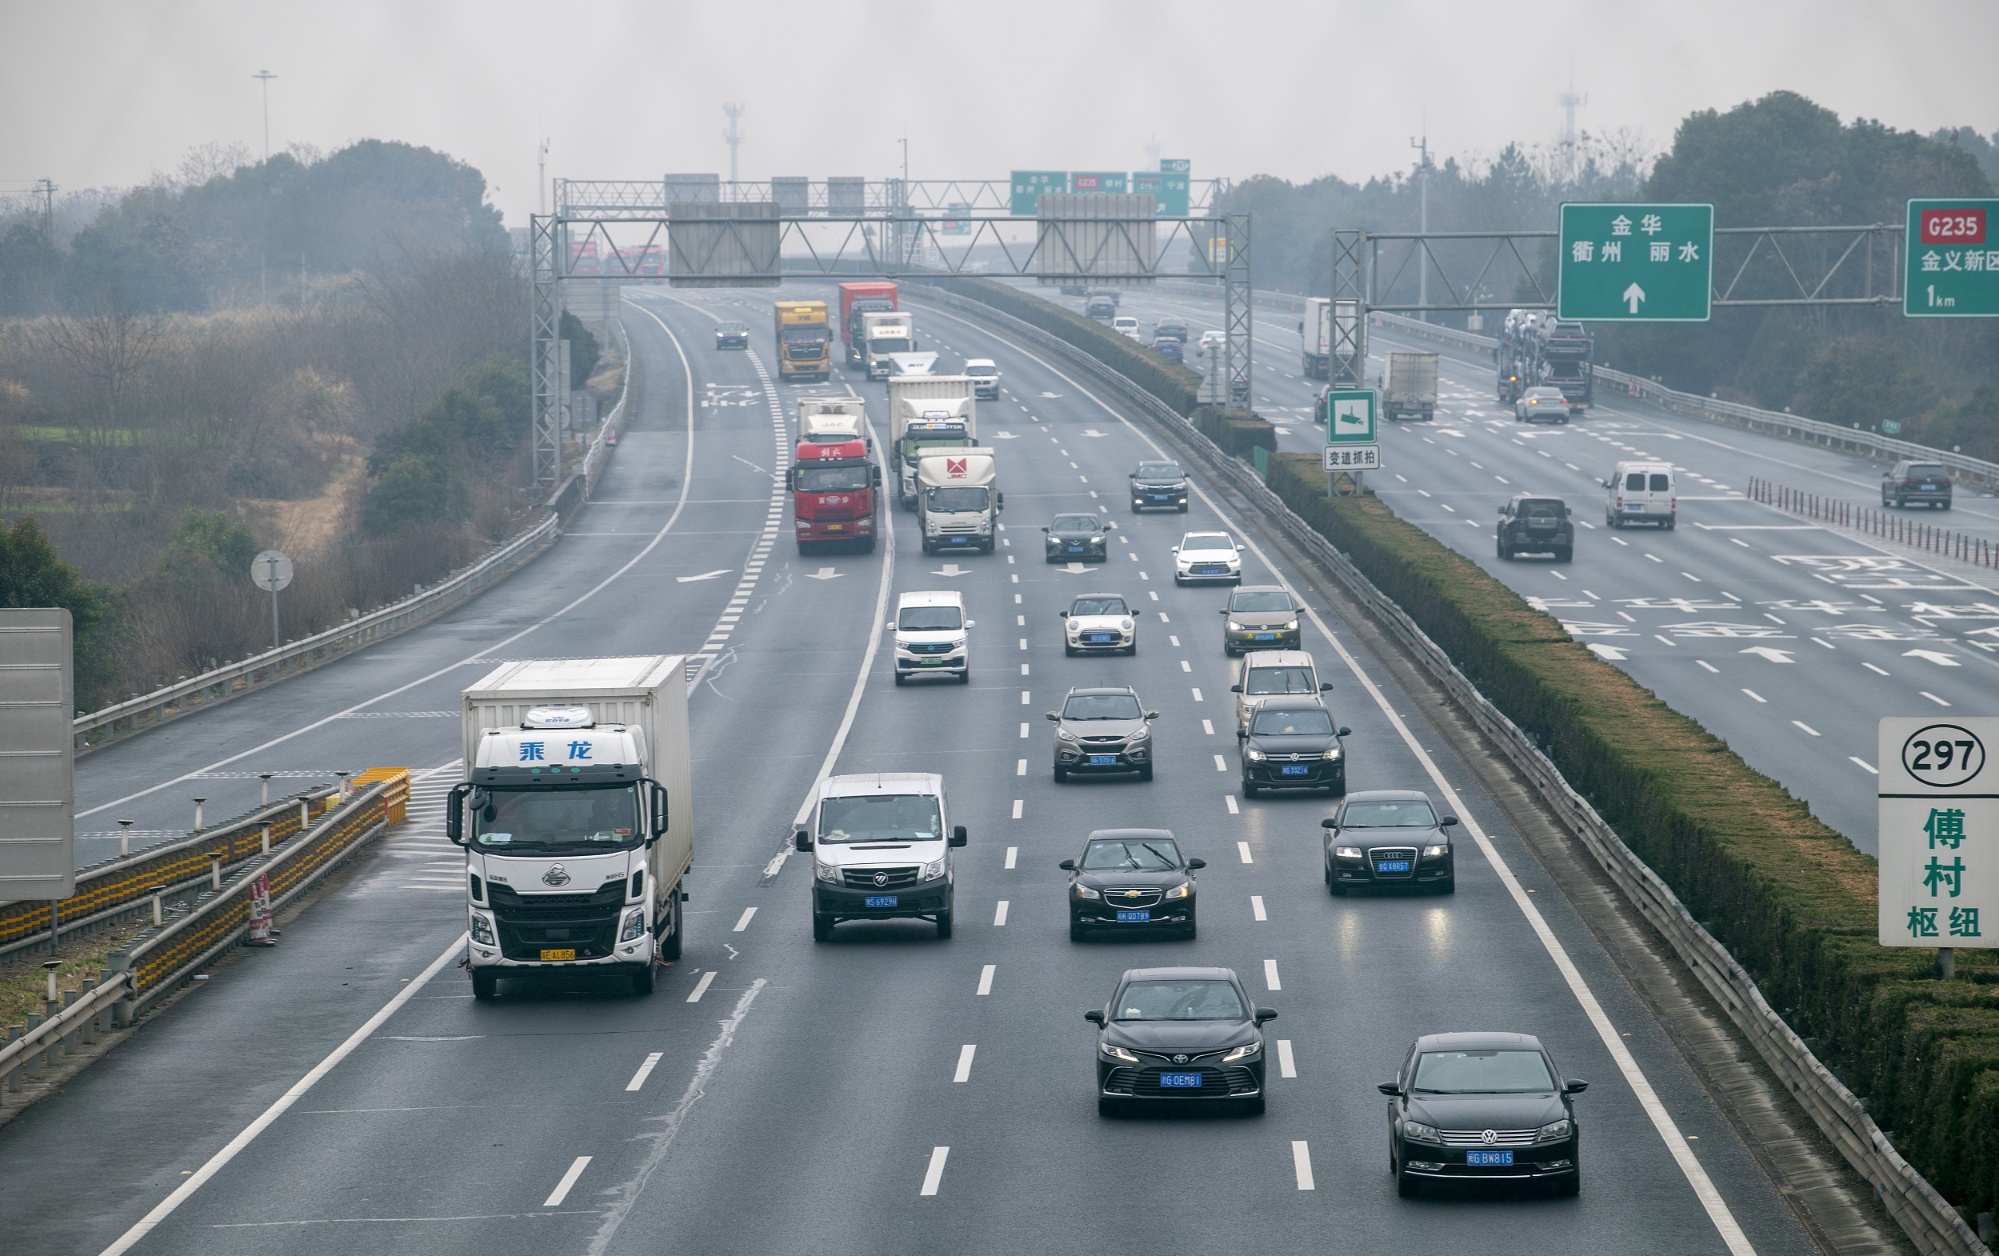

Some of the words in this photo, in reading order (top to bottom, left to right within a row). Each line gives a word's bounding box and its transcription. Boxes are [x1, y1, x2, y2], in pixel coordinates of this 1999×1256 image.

[1077, 178, 1097, 187] G235
[1611, 214, 1662, 236] 金华
[1929, 217, 1978, 236] G235
[1572, 241, 1622, 263] 衢州
[1649, 241, 1700, 263] 丽水
[1921, 250, 1999, 272] 金义新区
[1329, 450, 1375, 466] 变道抓拍
[520, 741, 592, 761] 乘龙
[1912, 740, 1974, 770] 297
[1923, 808, 1967, 897] 傅村
[866, 897, 897, 906] S6929H
[1907, 906, 1981, 938] 枢纽
